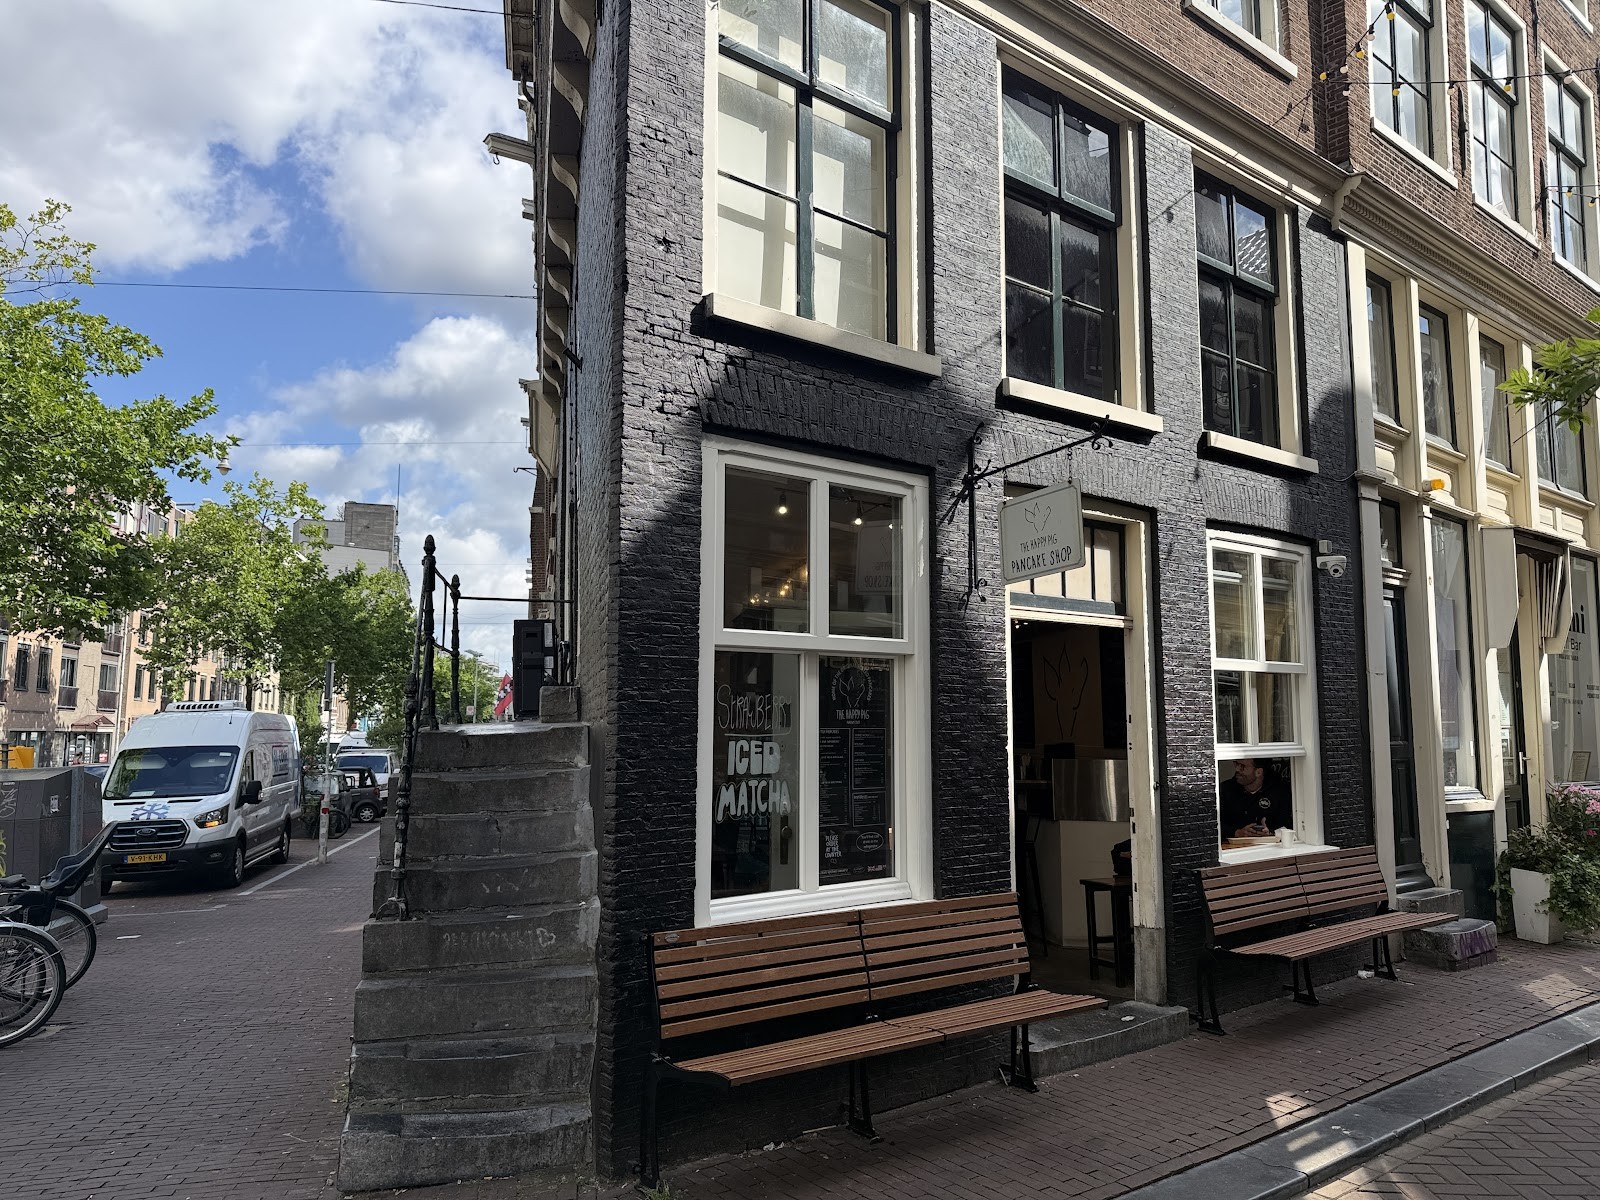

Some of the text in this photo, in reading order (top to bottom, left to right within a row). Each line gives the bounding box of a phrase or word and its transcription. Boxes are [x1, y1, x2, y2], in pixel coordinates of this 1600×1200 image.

[1020, 533, 1058, 553] THE HAPPY PIG
[1011, 545, 1072, 573] PANCAKE SHOP
[1570, 638, 1581, 651] Bar
[836, 709, 845, 720] THE
[861, 709, 870, 720] PIG
[727, 739, 781, 776] ICED
[716, 779, 792, 823] MATCHA
[130, 854, 164, 862] V-91-KHK
